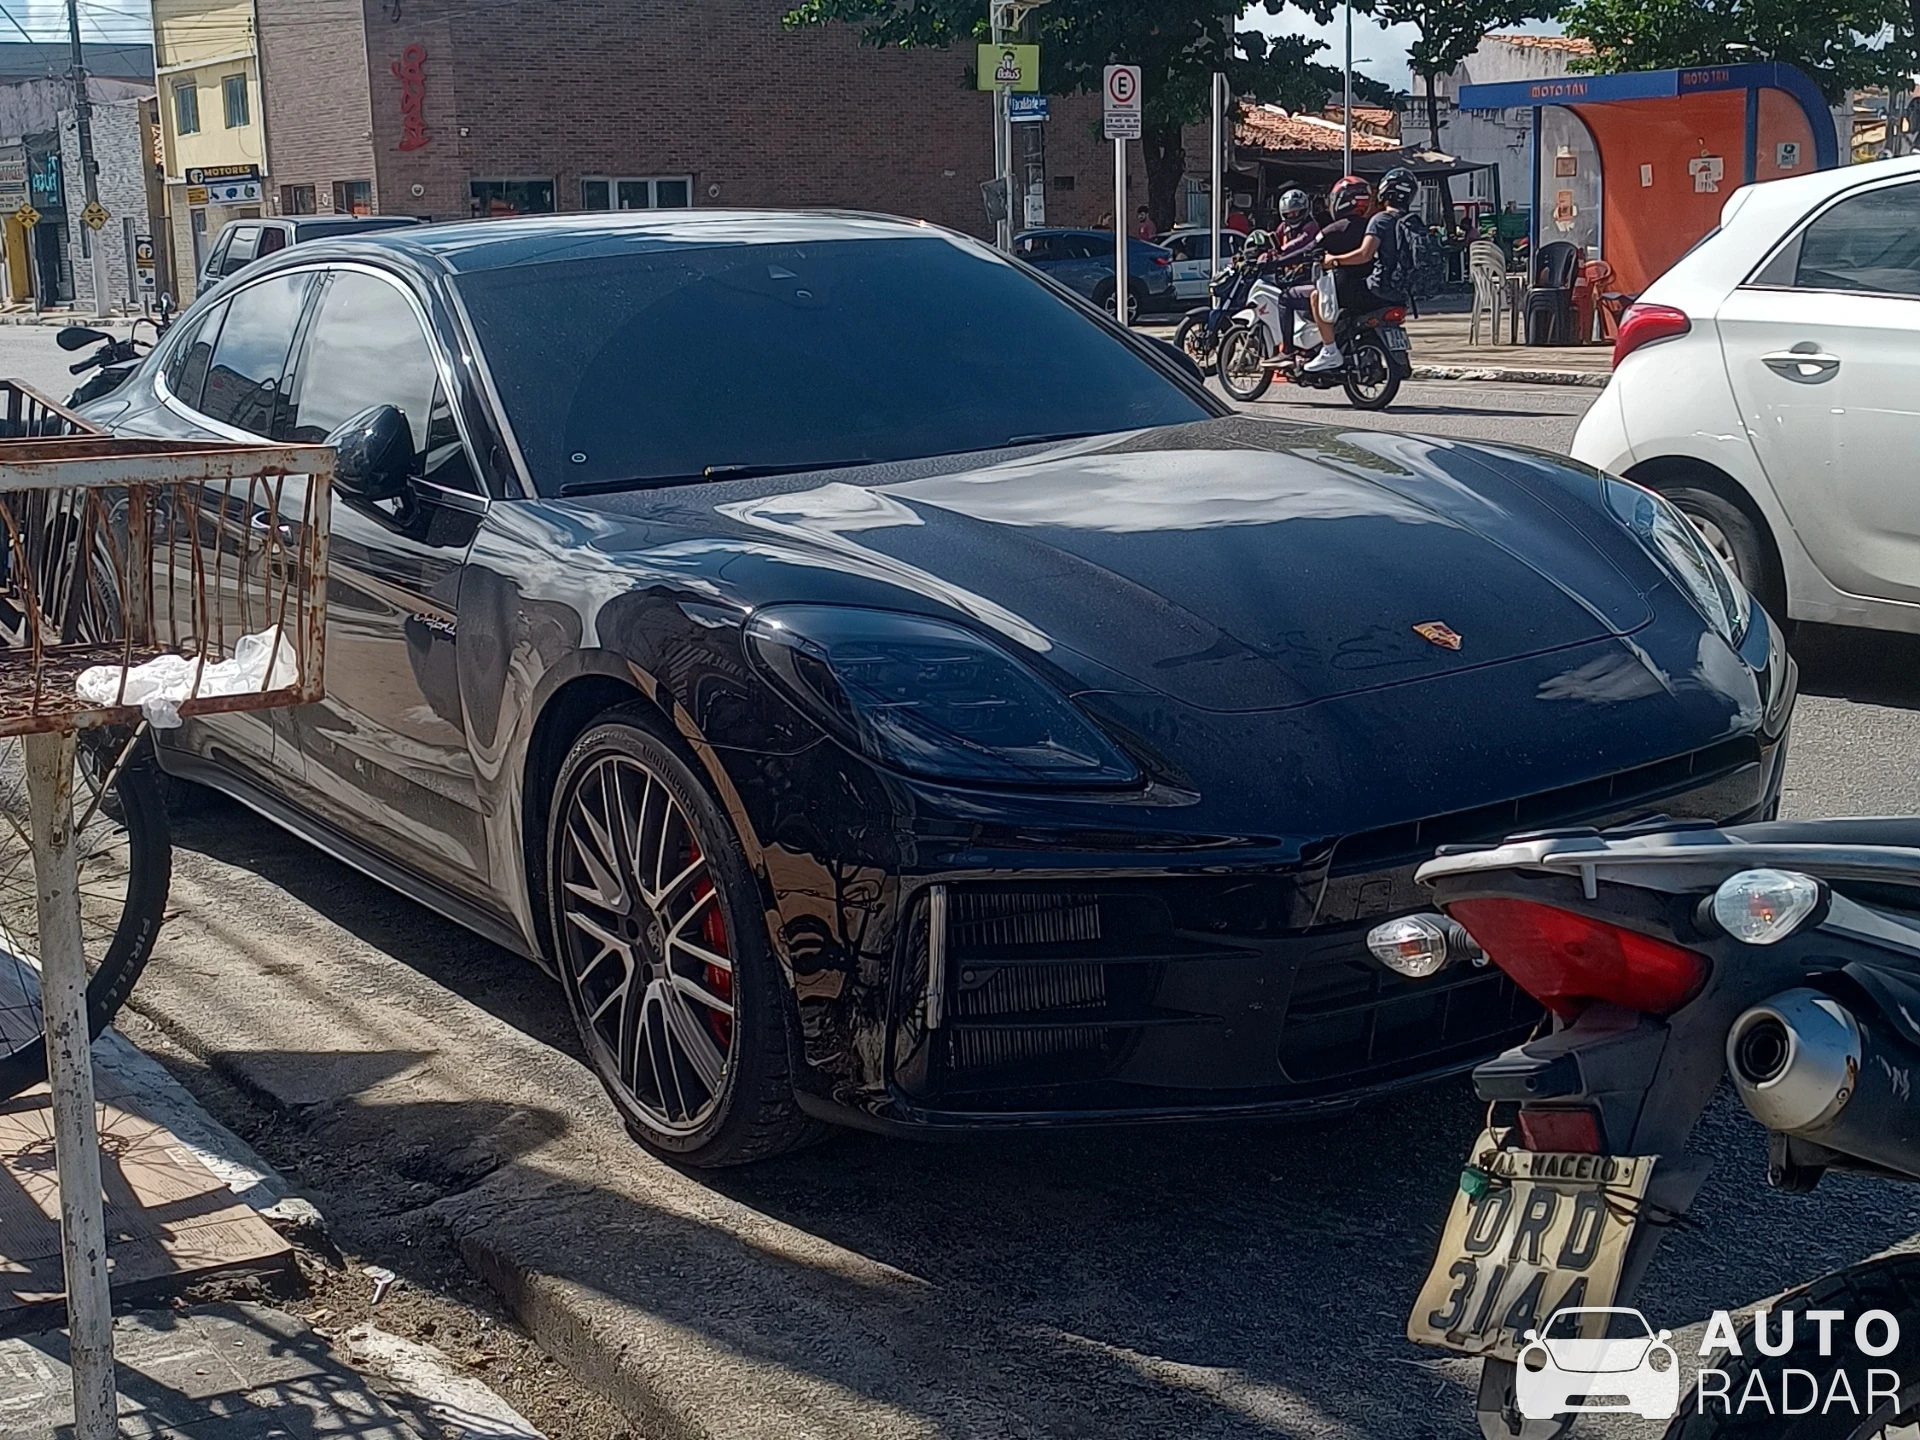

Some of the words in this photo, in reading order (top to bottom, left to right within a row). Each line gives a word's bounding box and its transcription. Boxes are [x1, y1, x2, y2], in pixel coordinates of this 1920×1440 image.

[1118, 76, 1127, 94] E
[1529, 85, 1563, 98] MOTO
[203, 165, 251, 177] MOTORES
[100, 917, 151, 1011] PIRELLI
[1464, 1187, 1608, 1270] ORD
[1428, 1260, 1590, 1346] 3144
